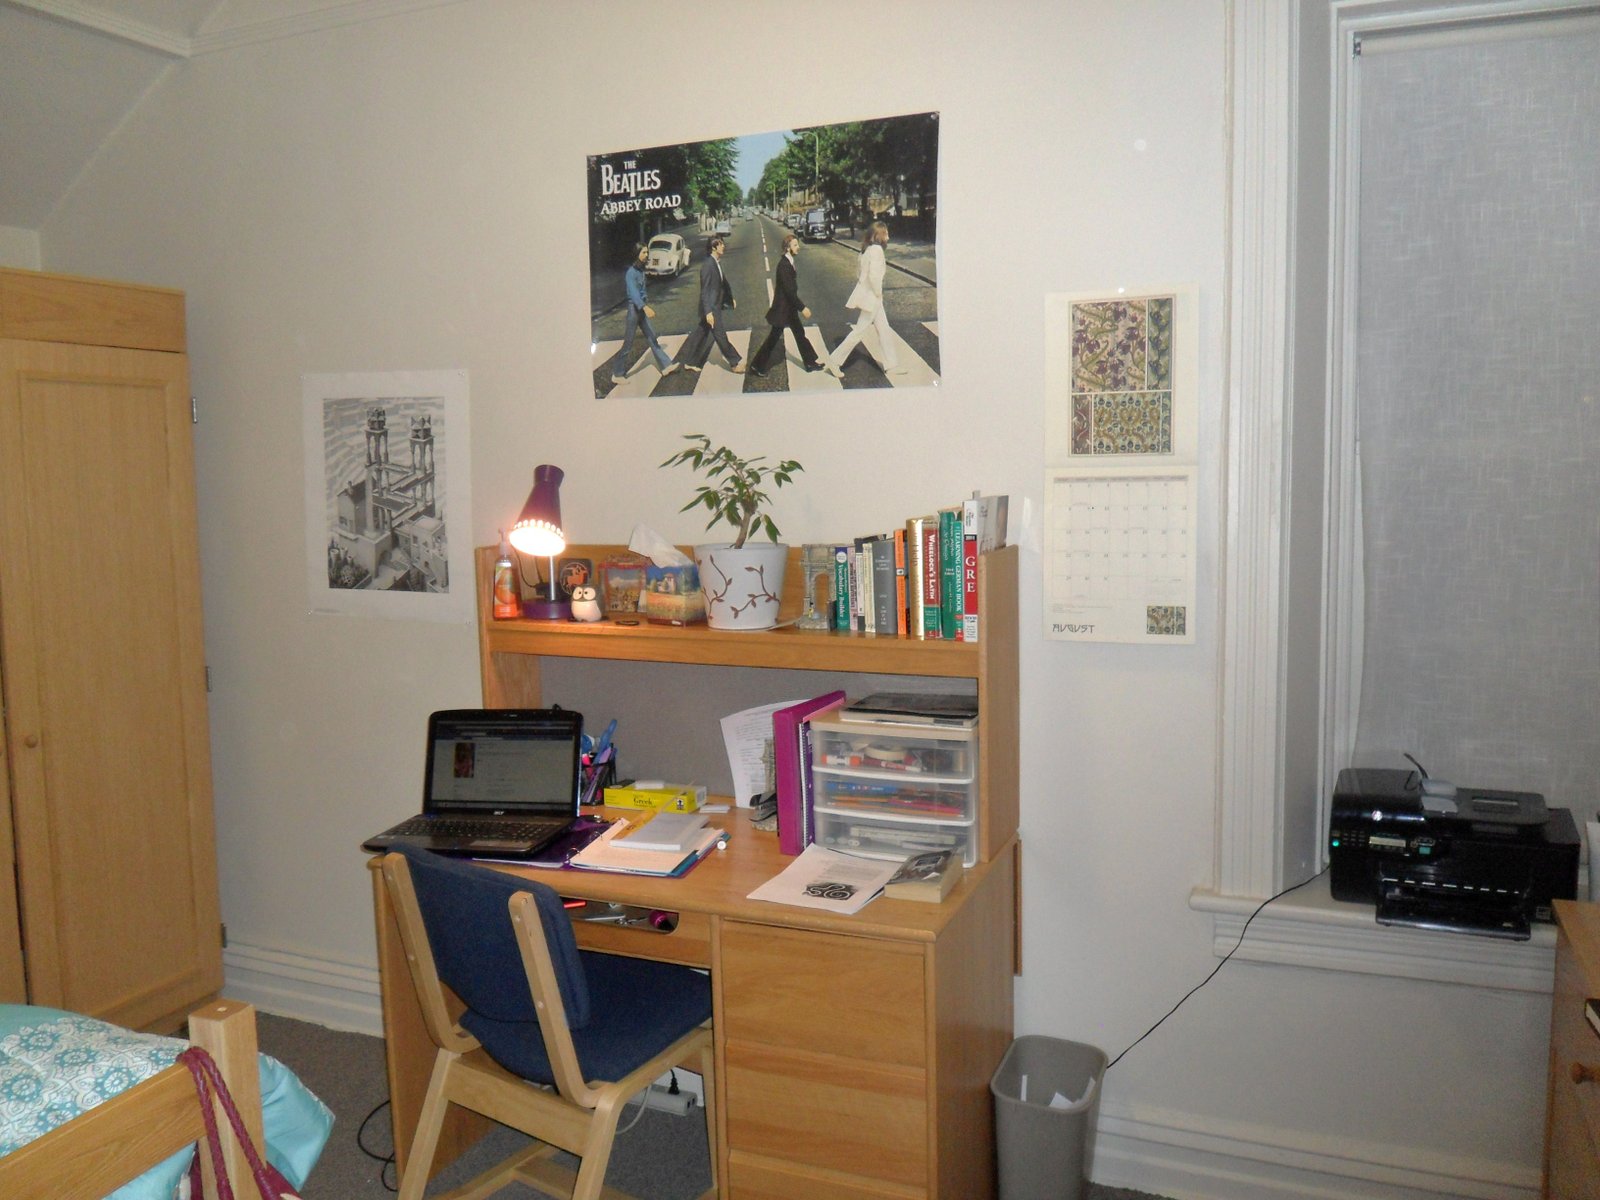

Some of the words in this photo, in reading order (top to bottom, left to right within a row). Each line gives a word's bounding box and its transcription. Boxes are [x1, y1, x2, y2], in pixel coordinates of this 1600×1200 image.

[624, 161, 637, 170] THE
[601, 164, 661, 197] BEATLES
[600, 199, 642, 215] ABBEY
[644, 195, 681, 210] ROAD
[954, 532, 962, 564] LEARNING
[837, 564, 845, 596] Vocabulary
[965, 556, 977, 594] GRE
[928, 579, 936, 600] LATIN
[633, 798, 653, 807] Greek
